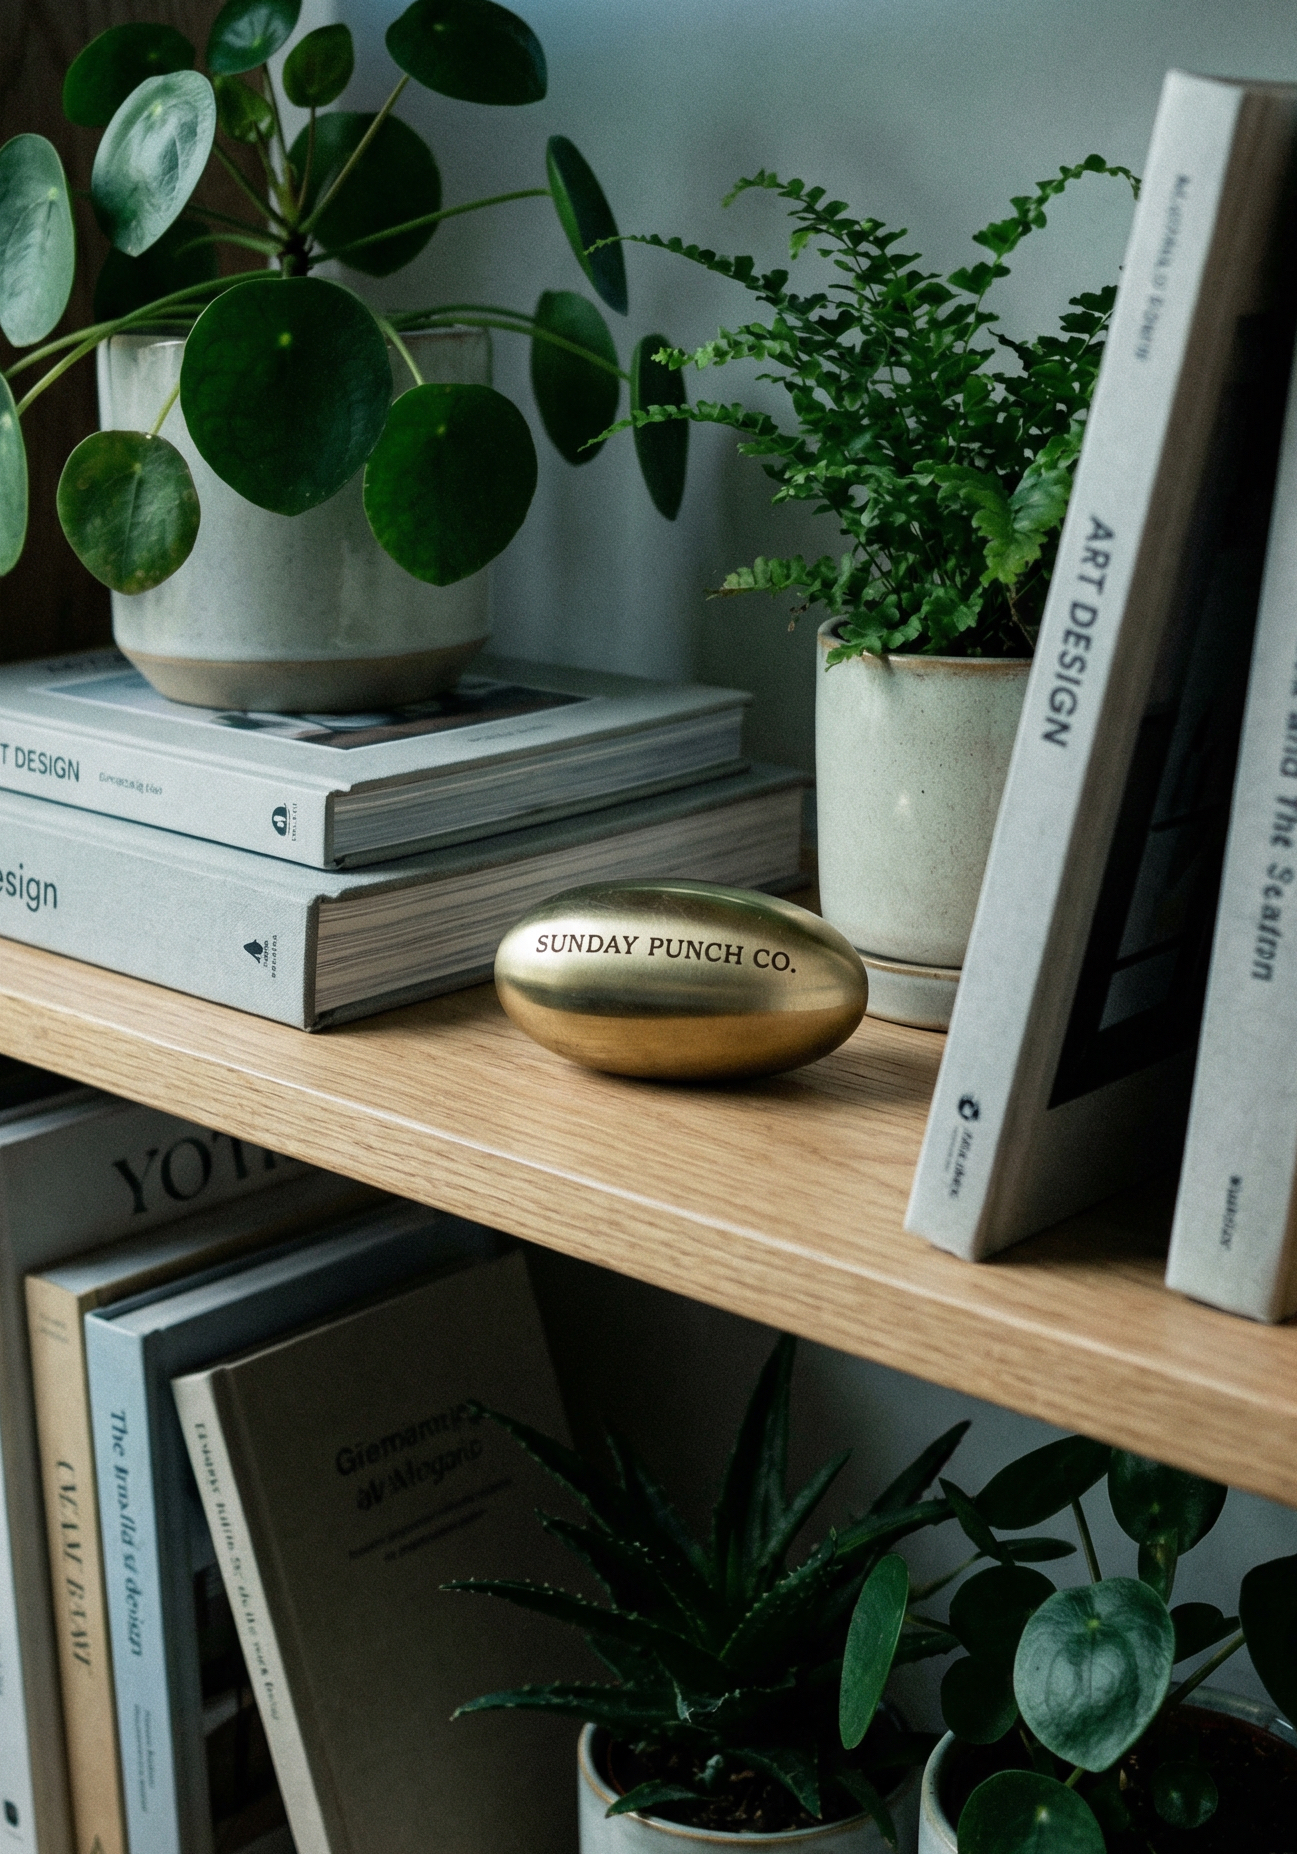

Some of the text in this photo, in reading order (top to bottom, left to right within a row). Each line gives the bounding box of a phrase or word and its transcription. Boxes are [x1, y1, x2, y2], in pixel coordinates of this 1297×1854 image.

[1040, 514, 1116, 748] ART DESIGN
[15, 746, 80, 783] DESIGN
[536, 934, 797, 974] SUNDAY PUNCH CO.
